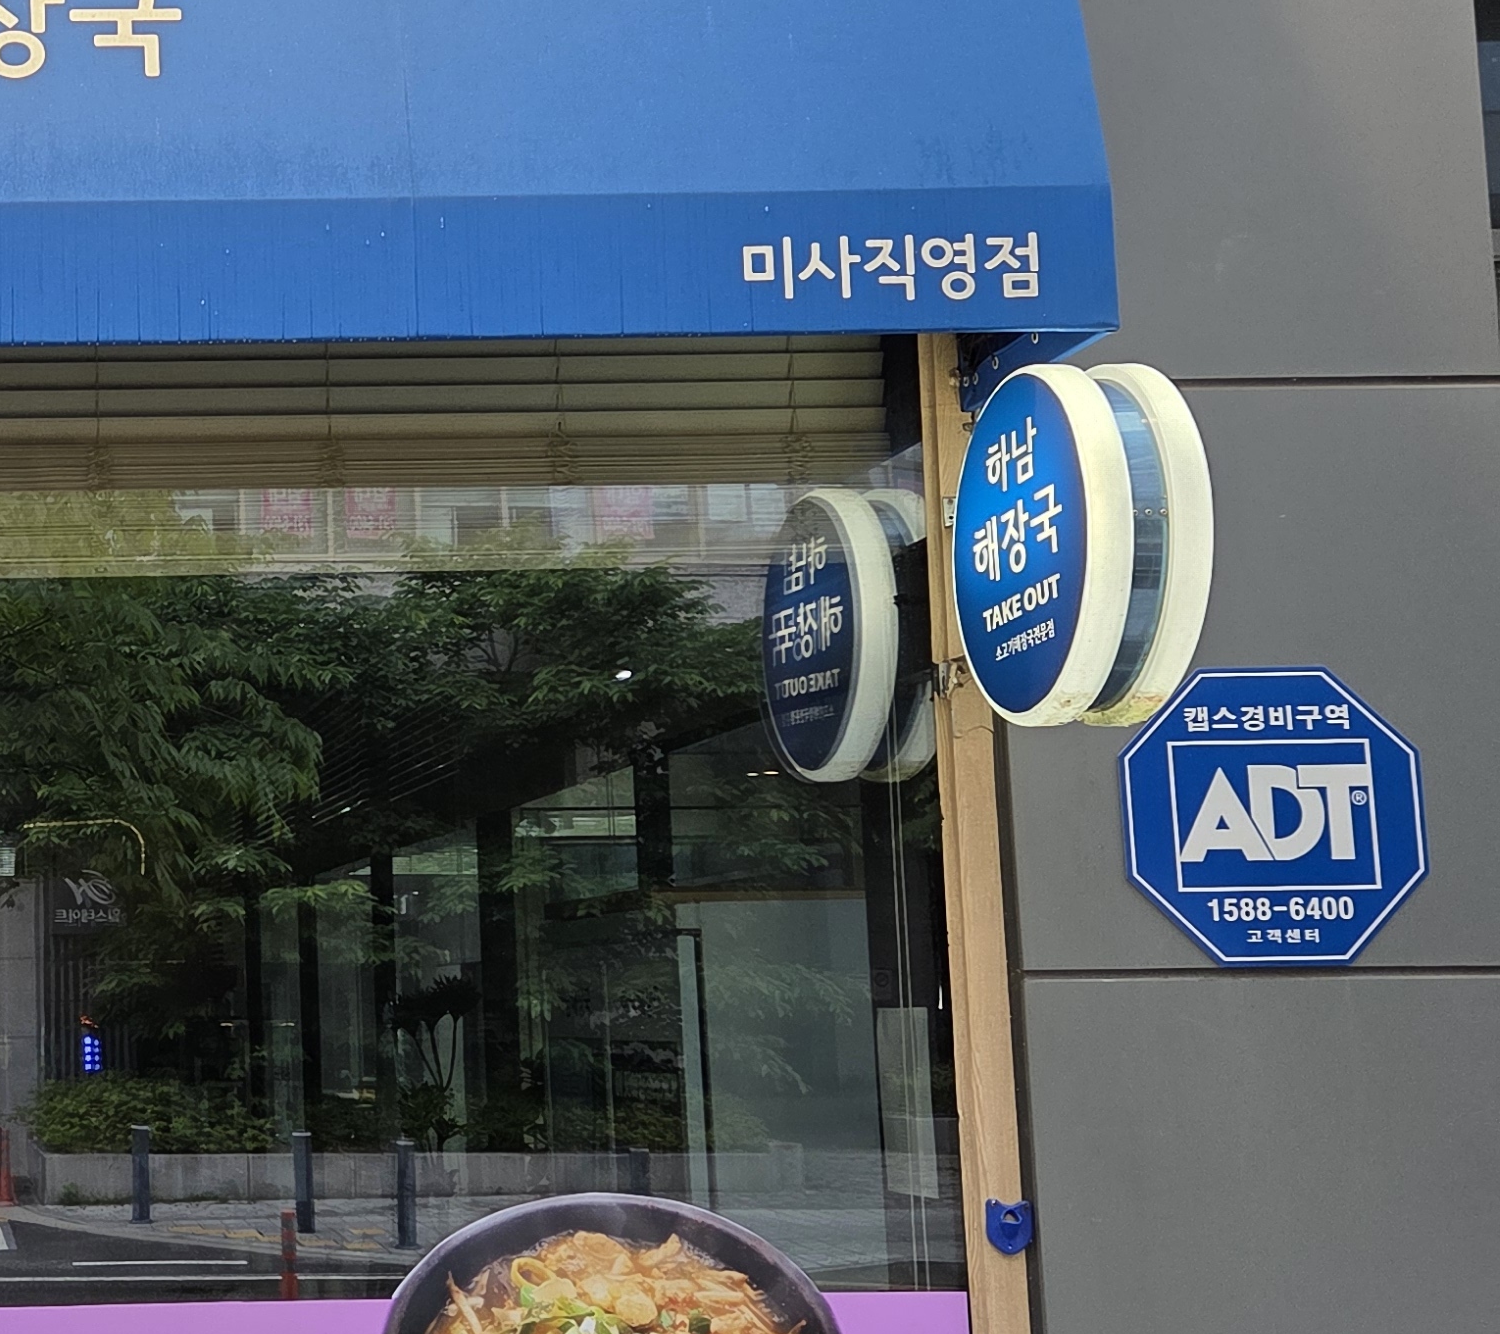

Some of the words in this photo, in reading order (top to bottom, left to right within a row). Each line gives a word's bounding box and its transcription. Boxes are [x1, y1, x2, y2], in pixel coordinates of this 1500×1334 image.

[742, 231, 1040, 301] 미사직영점
[985, 416, 1037, 492] 하남
[972, 483, 1063, 582] 해장국
[982, 593, 1024, 633] TAKE
[1023, 573, 1062, 612] OUT
[1183, 703, 1351, 732] 캡스경비구역
[1180, 763, 1368, 864] ADT
[1206, 896, 1354, 922] 1588-6400
[1245, 927, 1321, 945] 고객센터
